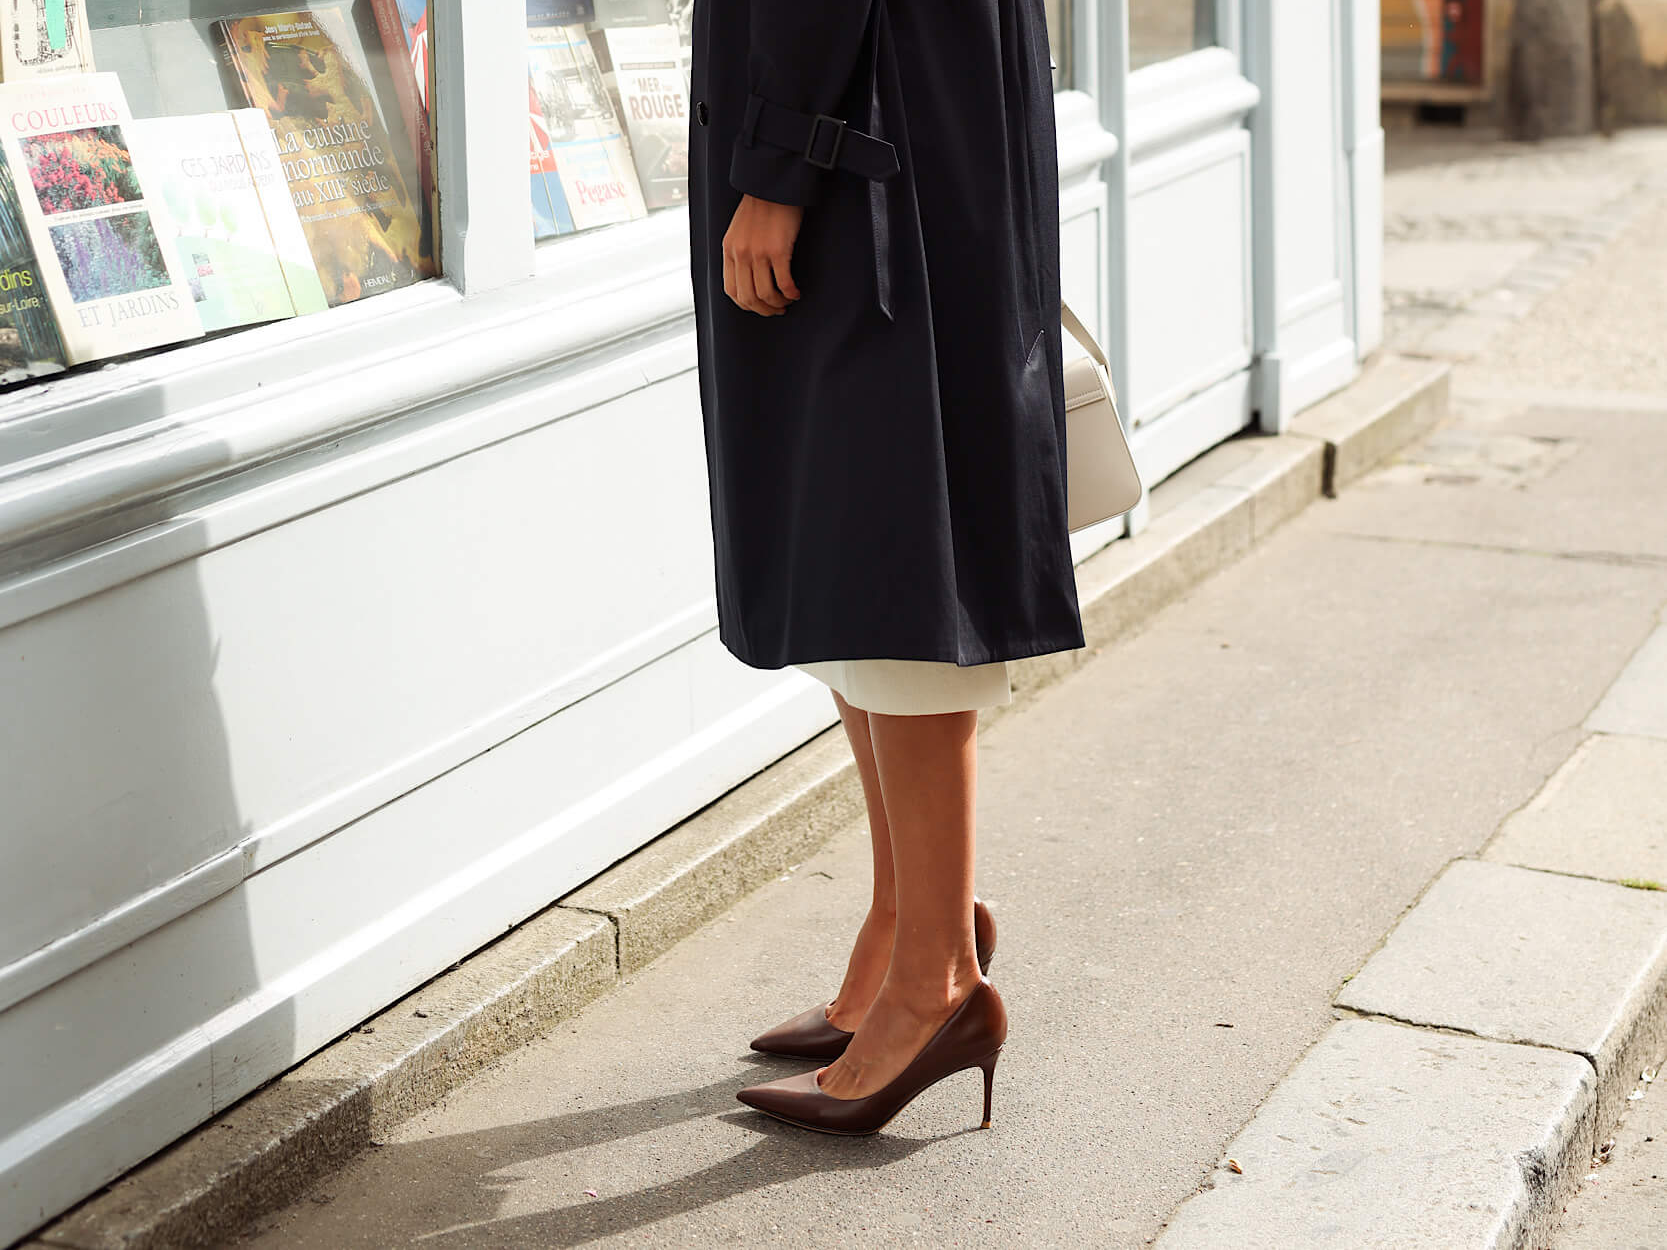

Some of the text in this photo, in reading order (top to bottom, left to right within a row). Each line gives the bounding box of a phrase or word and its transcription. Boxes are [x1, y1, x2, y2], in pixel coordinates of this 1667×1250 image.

[638, 77, 661, 93] MER
[12, 101, 118, 132] COULEURS
[628, 94, 685, 120] ROUGE
[270, 117, 372, 156] La cuisine
[281, 140, 385, 182] normande
[292, 189, 316, 208] au
[350, 170, 391, 196] siècle
[77, 291, 180, 328] ET JARDINS
